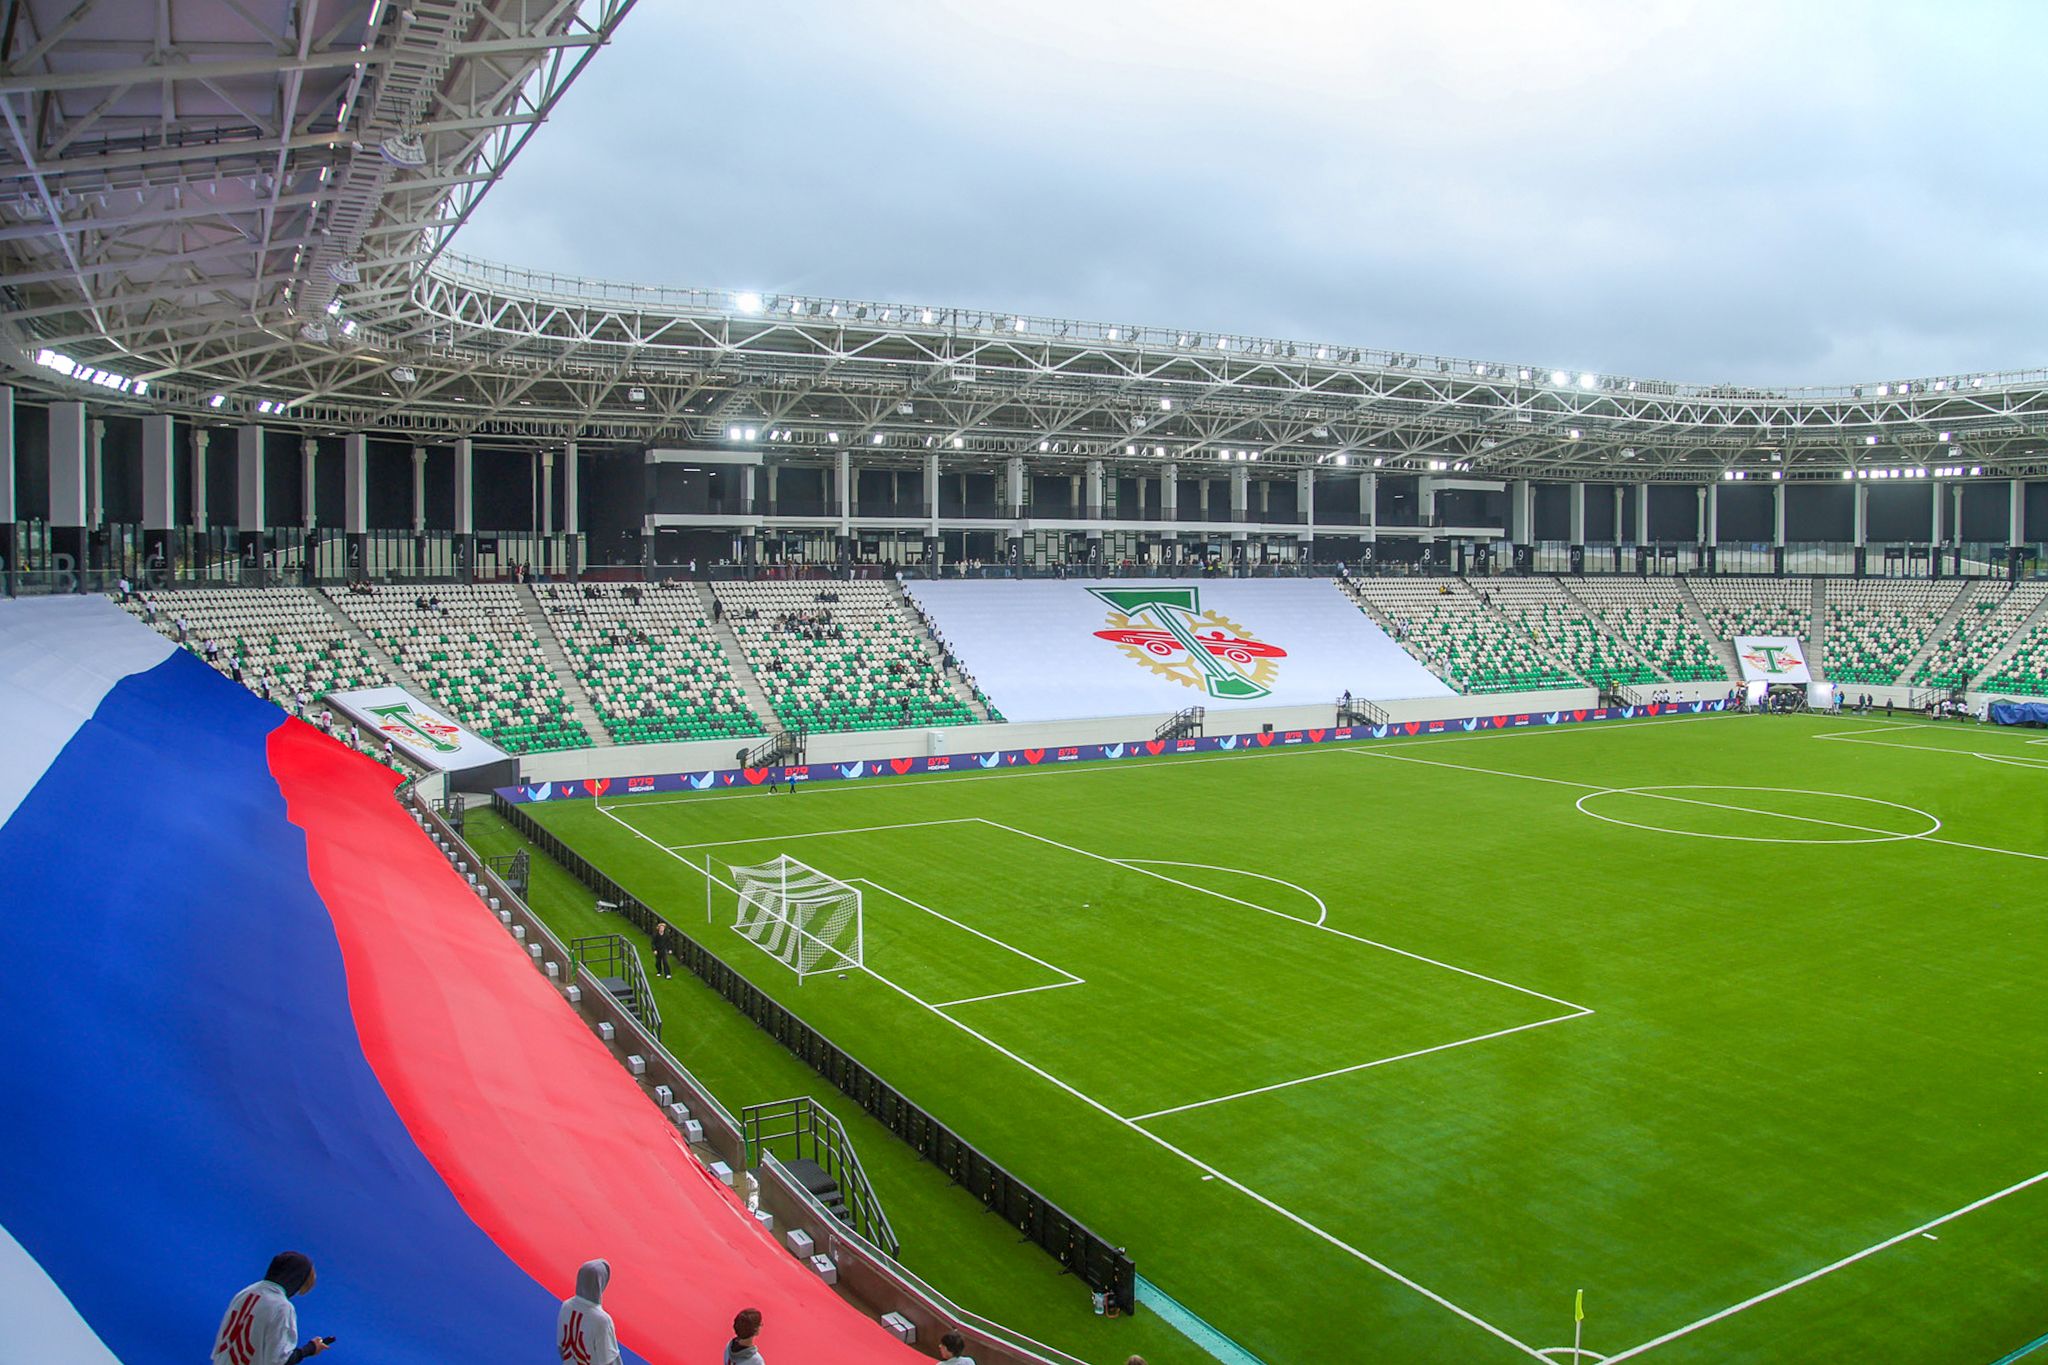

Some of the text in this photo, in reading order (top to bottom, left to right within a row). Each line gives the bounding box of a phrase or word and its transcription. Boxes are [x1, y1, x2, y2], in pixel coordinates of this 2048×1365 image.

[154, 541, 164, 559] 1
[247, 543, 255, 559] 1
[351, 544, 358, 559] 2
[927, 545, 932, 558] 5
[1011, 545, 1017, 558] 5
[1091, 545, 1096, 558] 6
[1166, 545, 1172, 558] 6
[1236, 546, 1242, 558] 7
[1302, 547, 1308, 559] 7
[1365, 547, 1372, 559] 8
[1424, 548, 1430, 560] 8
[1479, 549, 1486, 560] 9
[1517, 549, 1524, 560] 9
[628, 777, 655, 787] 879
